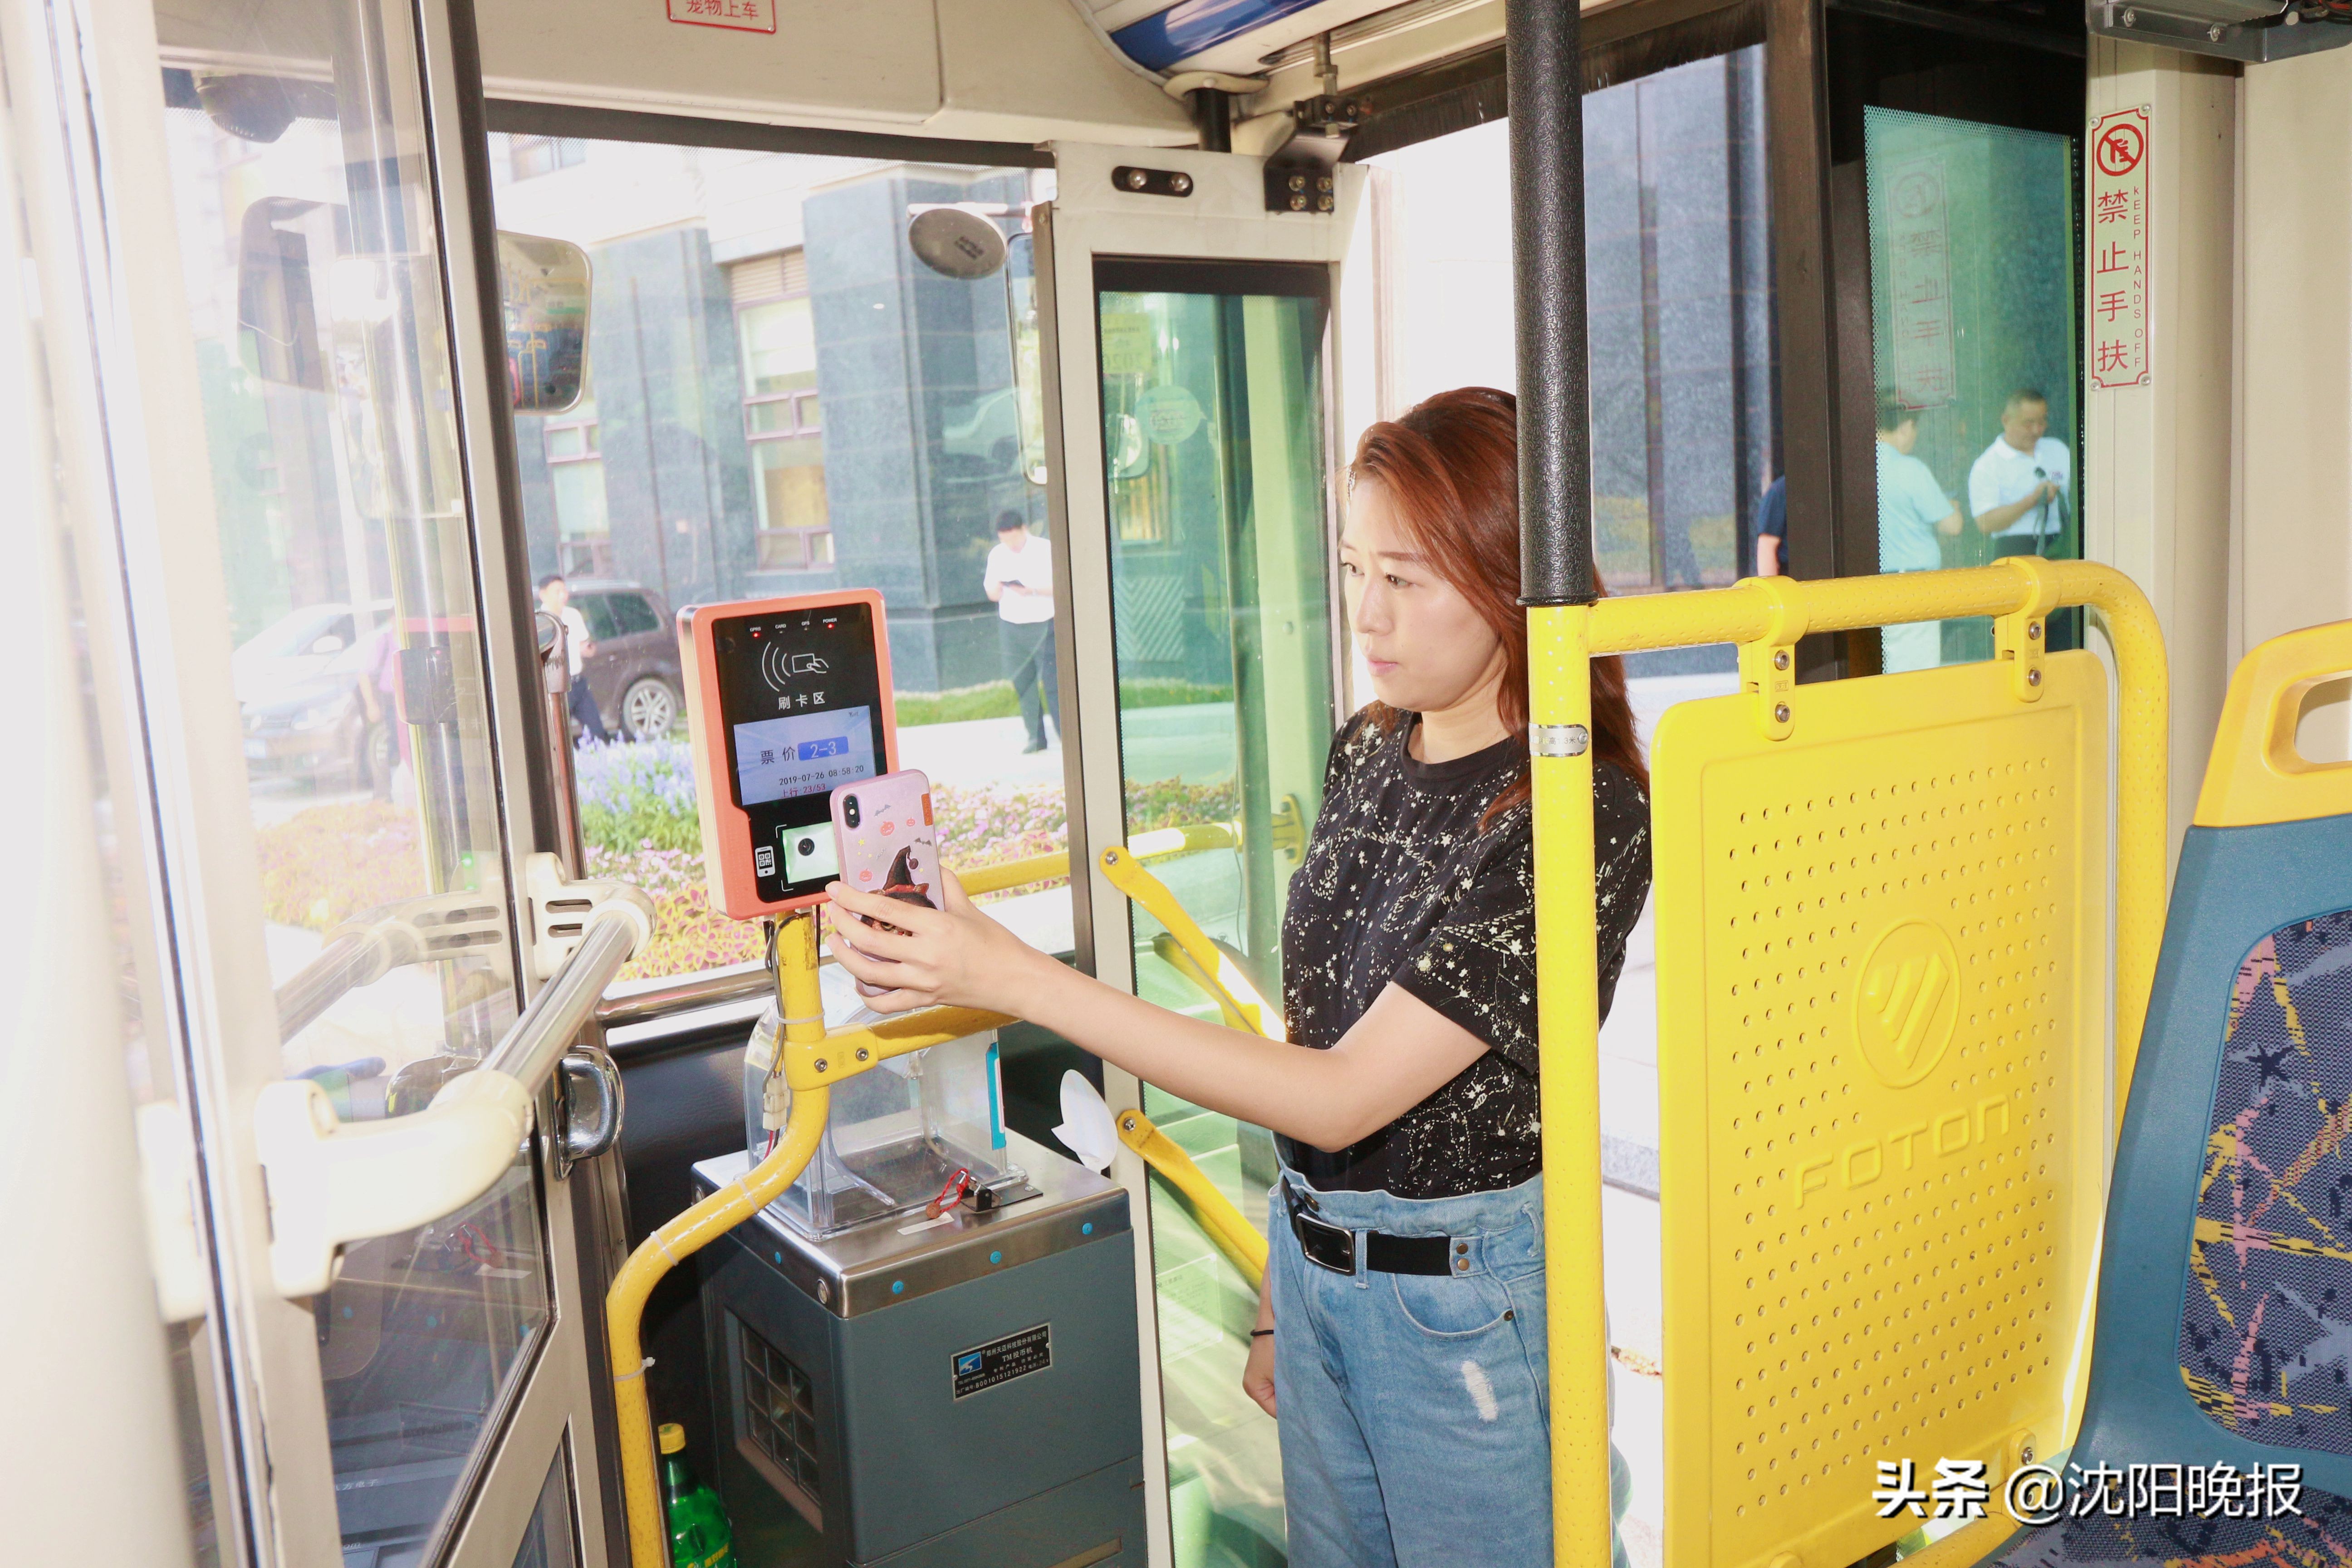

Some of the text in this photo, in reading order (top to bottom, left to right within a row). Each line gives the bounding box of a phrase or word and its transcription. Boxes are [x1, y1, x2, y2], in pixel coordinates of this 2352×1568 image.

[2097, 189, 2129, 372] 禁止手扶
[2134, 250, 2142, 319] HANDS
[2134, 328, 2143, 368] OFF
[779, 691, 825, 710] 刷卡区
[760, 741, 837, 764] 票价 2-3
[779, 765, 864, 785] 2019-07-26 08:58:20
[1794, 1093, 2009, 1210] FOTON
[1002, 1347, 1033, 1362] TM 投币机
